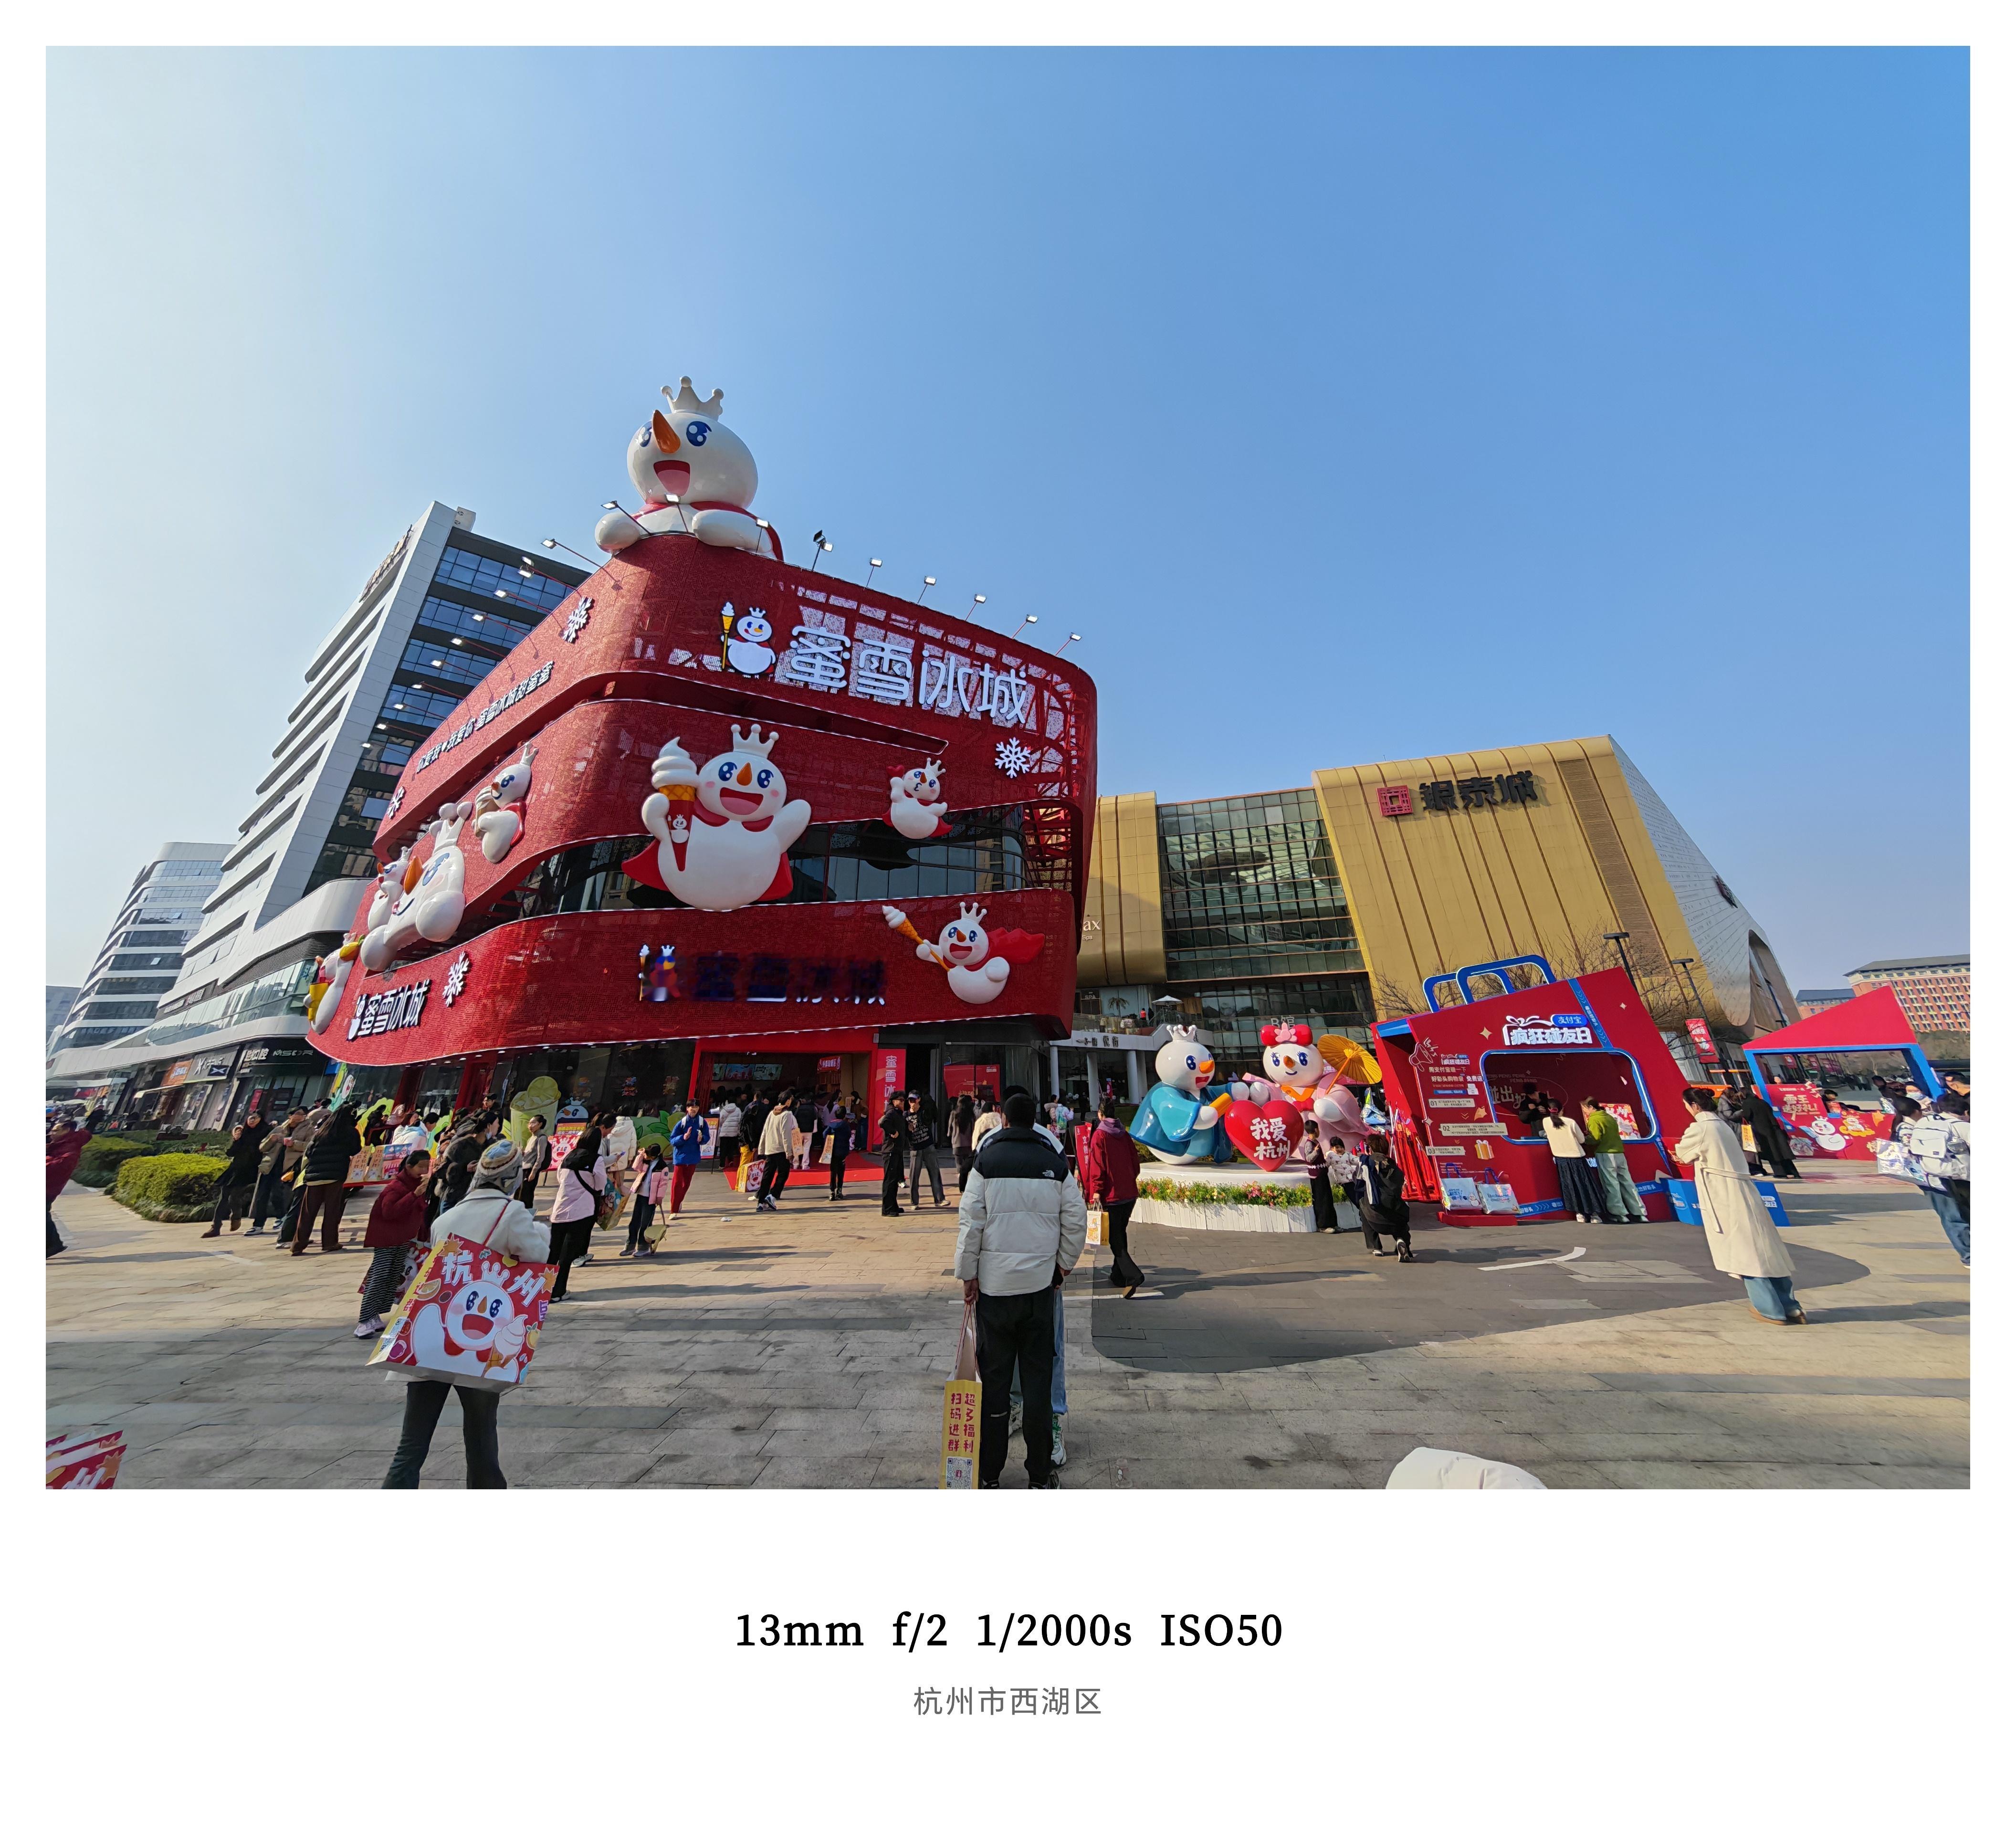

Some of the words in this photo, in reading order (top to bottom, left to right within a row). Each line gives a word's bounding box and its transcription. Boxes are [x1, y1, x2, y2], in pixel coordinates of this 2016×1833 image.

[785, 625, 1027, 724] 蜜雪冰城
[1418, 769, 1538, 811] 银泰城
[1083, 919, 1102, 932] ax
[357, 979, 431, 1036] 蜜雪冰城
[1558, 1016, 1582, 1024] 支付宝
[1511, 1027, 1593, 1045] 疯狂碰友日
[884, 1054, 898, 1111] 蜜雪冰
[1250, 1117, 1288, 1142] 我爱
[1253, 1139, 1291, 1162] 杭州
[441, 1249, 546, 1307] 杭州
[948, 1392, 962, 1452] 扫码进群
[963, 1392, 976, 1454] 超多福利
